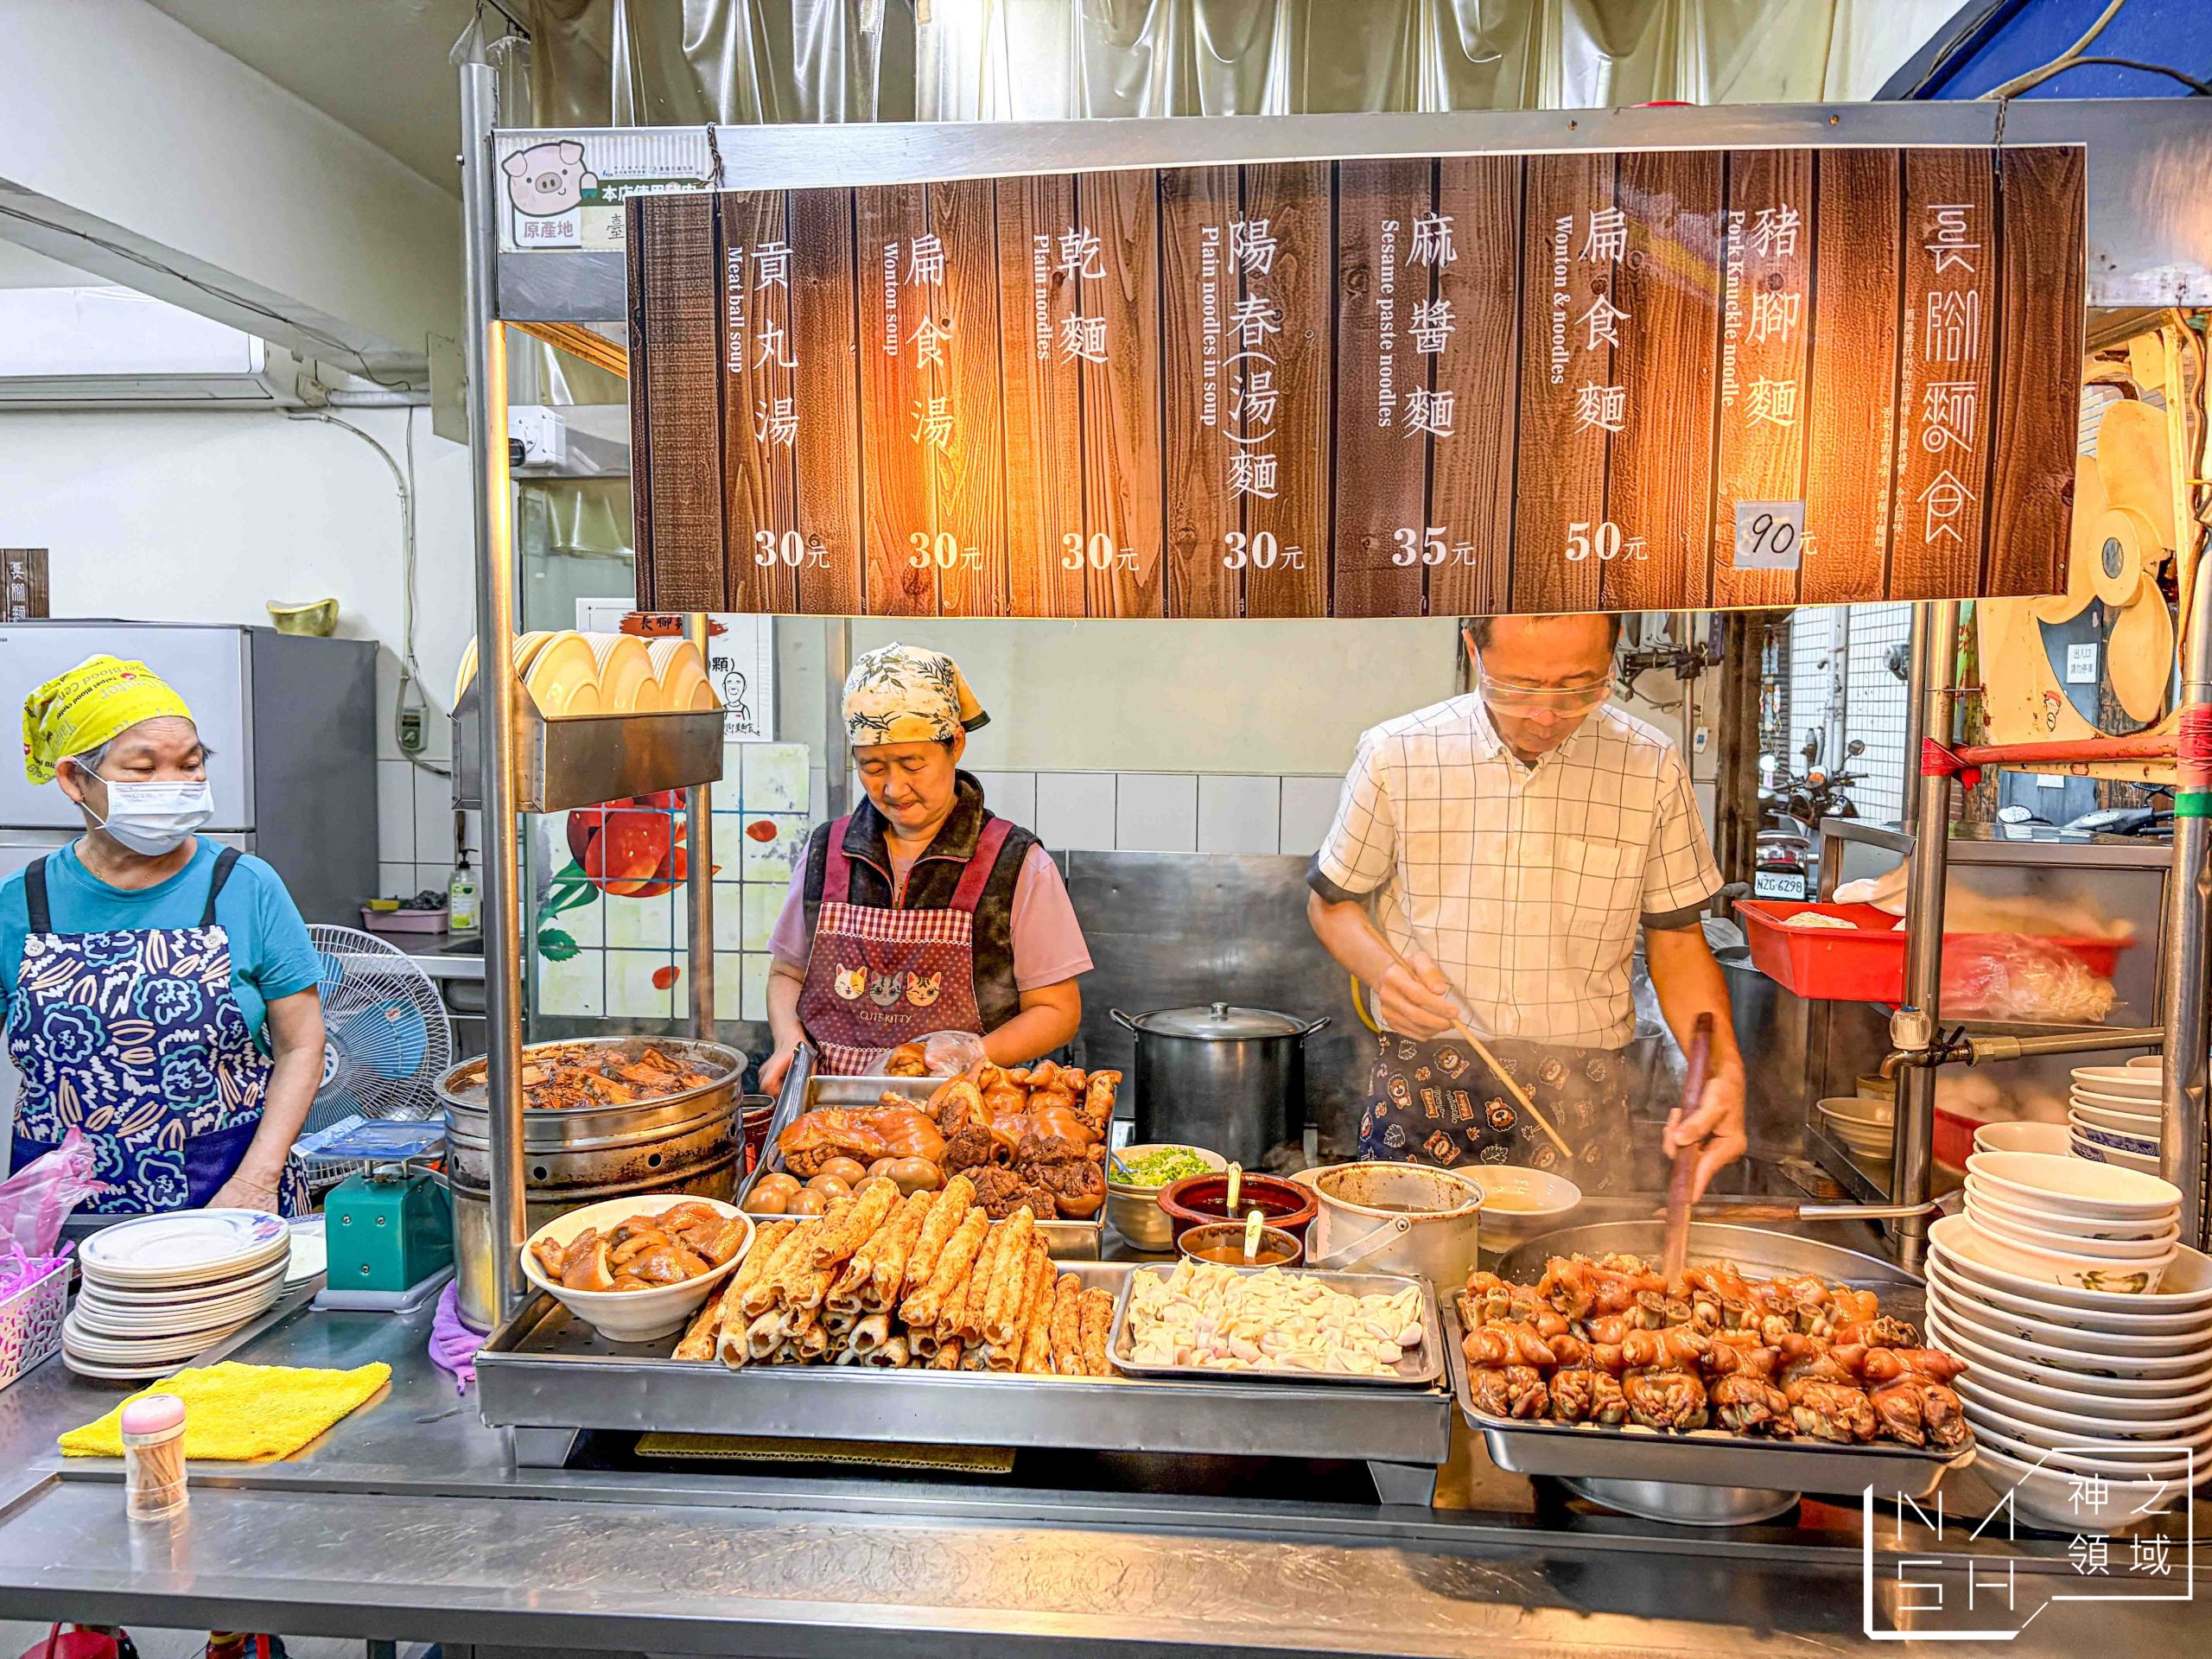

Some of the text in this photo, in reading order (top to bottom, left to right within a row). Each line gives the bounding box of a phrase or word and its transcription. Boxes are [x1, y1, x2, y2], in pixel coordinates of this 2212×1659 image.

[523, 219, 575, 239] 原產地
[728, 246, 745, 373] Meat ball soup
[750, 240, 801, 448] 貢丸湯
[883, 242, 899, 356] Wonton soup
[904, 232, 955, 448] 扁食湯
[1033, 234, 1053, 360] Plain noodles
[1057, 226, 1109, 365] 乾麵
[1199, 226, 1221, 426] Plain noodles in soup
[1223, 210, 1281, 501] 陽春(湯)麵
[1376, 219, 1400, 428] Sesame paste noodles
[1401, 212, 1458, 439] 麻醬麵
[1551, 214, 1573, 385] Wonton & noodles
[1573, 206, 1632, 434] 扁食麵
[1721, 209, 1745, 408] Pork Knuckle noodle
[1744, 203, 1802, 429] 豬腳麵
[754, 530, 830, 569] 30元
[909, 531, 985, 570] 30元
[1062, 532, 1140, 571] 30元
[1224, 531, 1306, 570] 30元
[1391, 526, 1477, 567] 35元
[1564, 521, 1649, 562] 50元
[1751, 513, 1795, 553] 90
[73, 687, 93, 705] Blood
[860, 1010, 912, 1024] CUTE KITTY
[1459, 1094, 1470, 1117] happy
